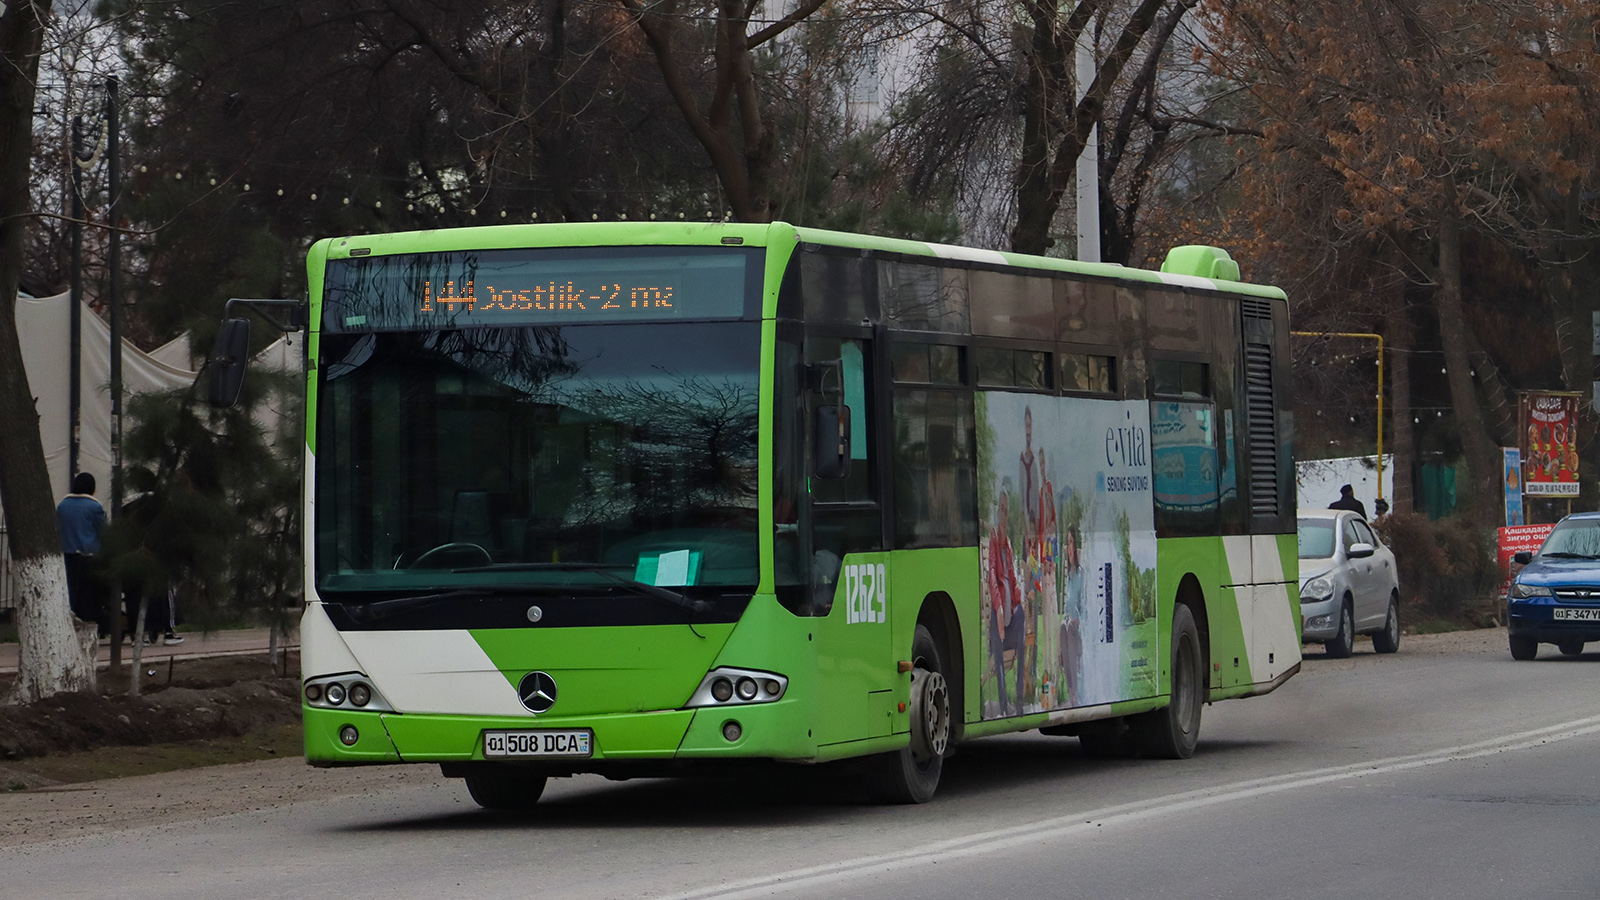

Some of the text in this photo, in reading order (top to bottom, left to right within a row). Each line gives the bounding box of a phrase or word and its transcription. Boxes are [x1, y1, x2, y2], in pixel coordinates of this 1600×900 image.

[421, 281, 477, 311] 144
[845, 563, 886, 625] 12629
[1555, 610, 1600, 620] 01 F 347 Y
[489, 738, 504, 751] 01
[508, 735, 539, 753] 508
[543, 735, 579, 752] DCA
